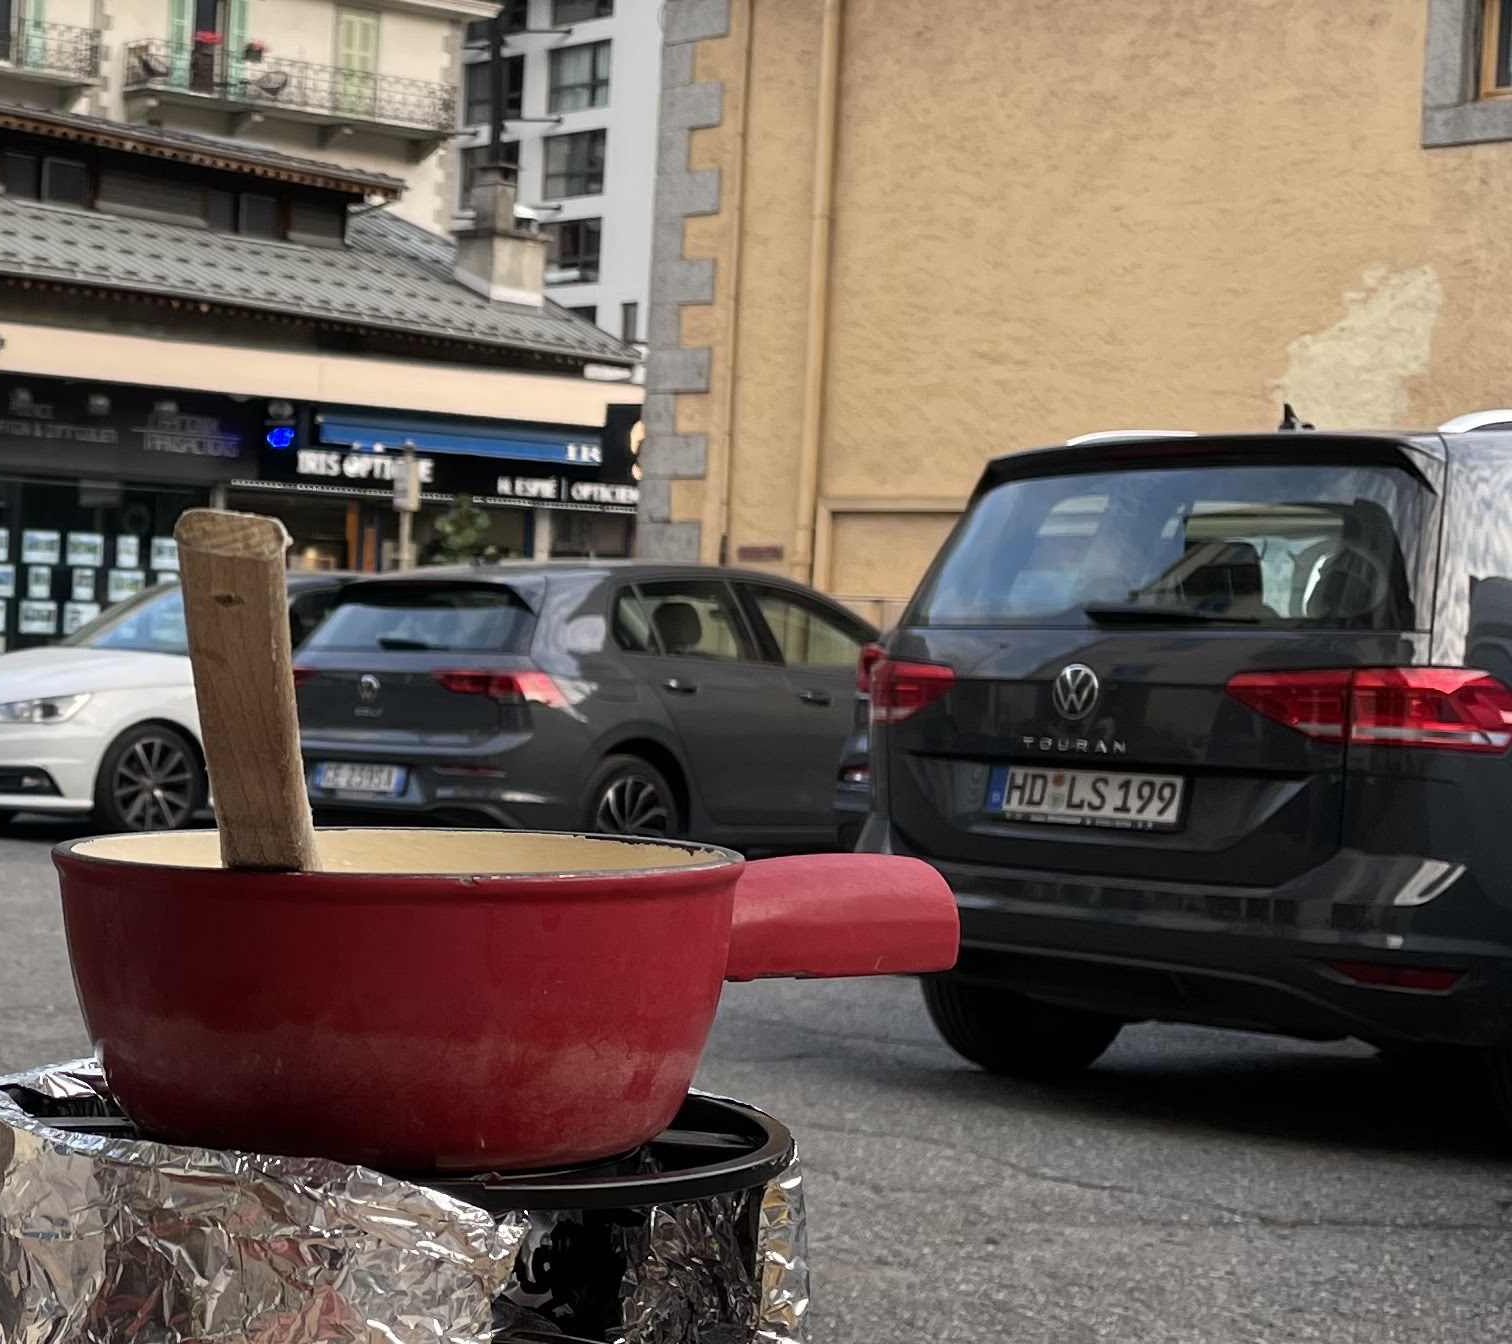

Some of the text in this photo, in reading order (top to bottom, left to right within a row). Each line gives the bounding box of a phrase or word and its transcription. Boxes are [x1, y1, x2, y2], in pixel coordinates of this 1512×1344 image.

[296, 448, 435, 484] IRIS OPTIE
[1022, 735, 1127, 755] TOURAN
[1005, 771, 1049, 807] HD
